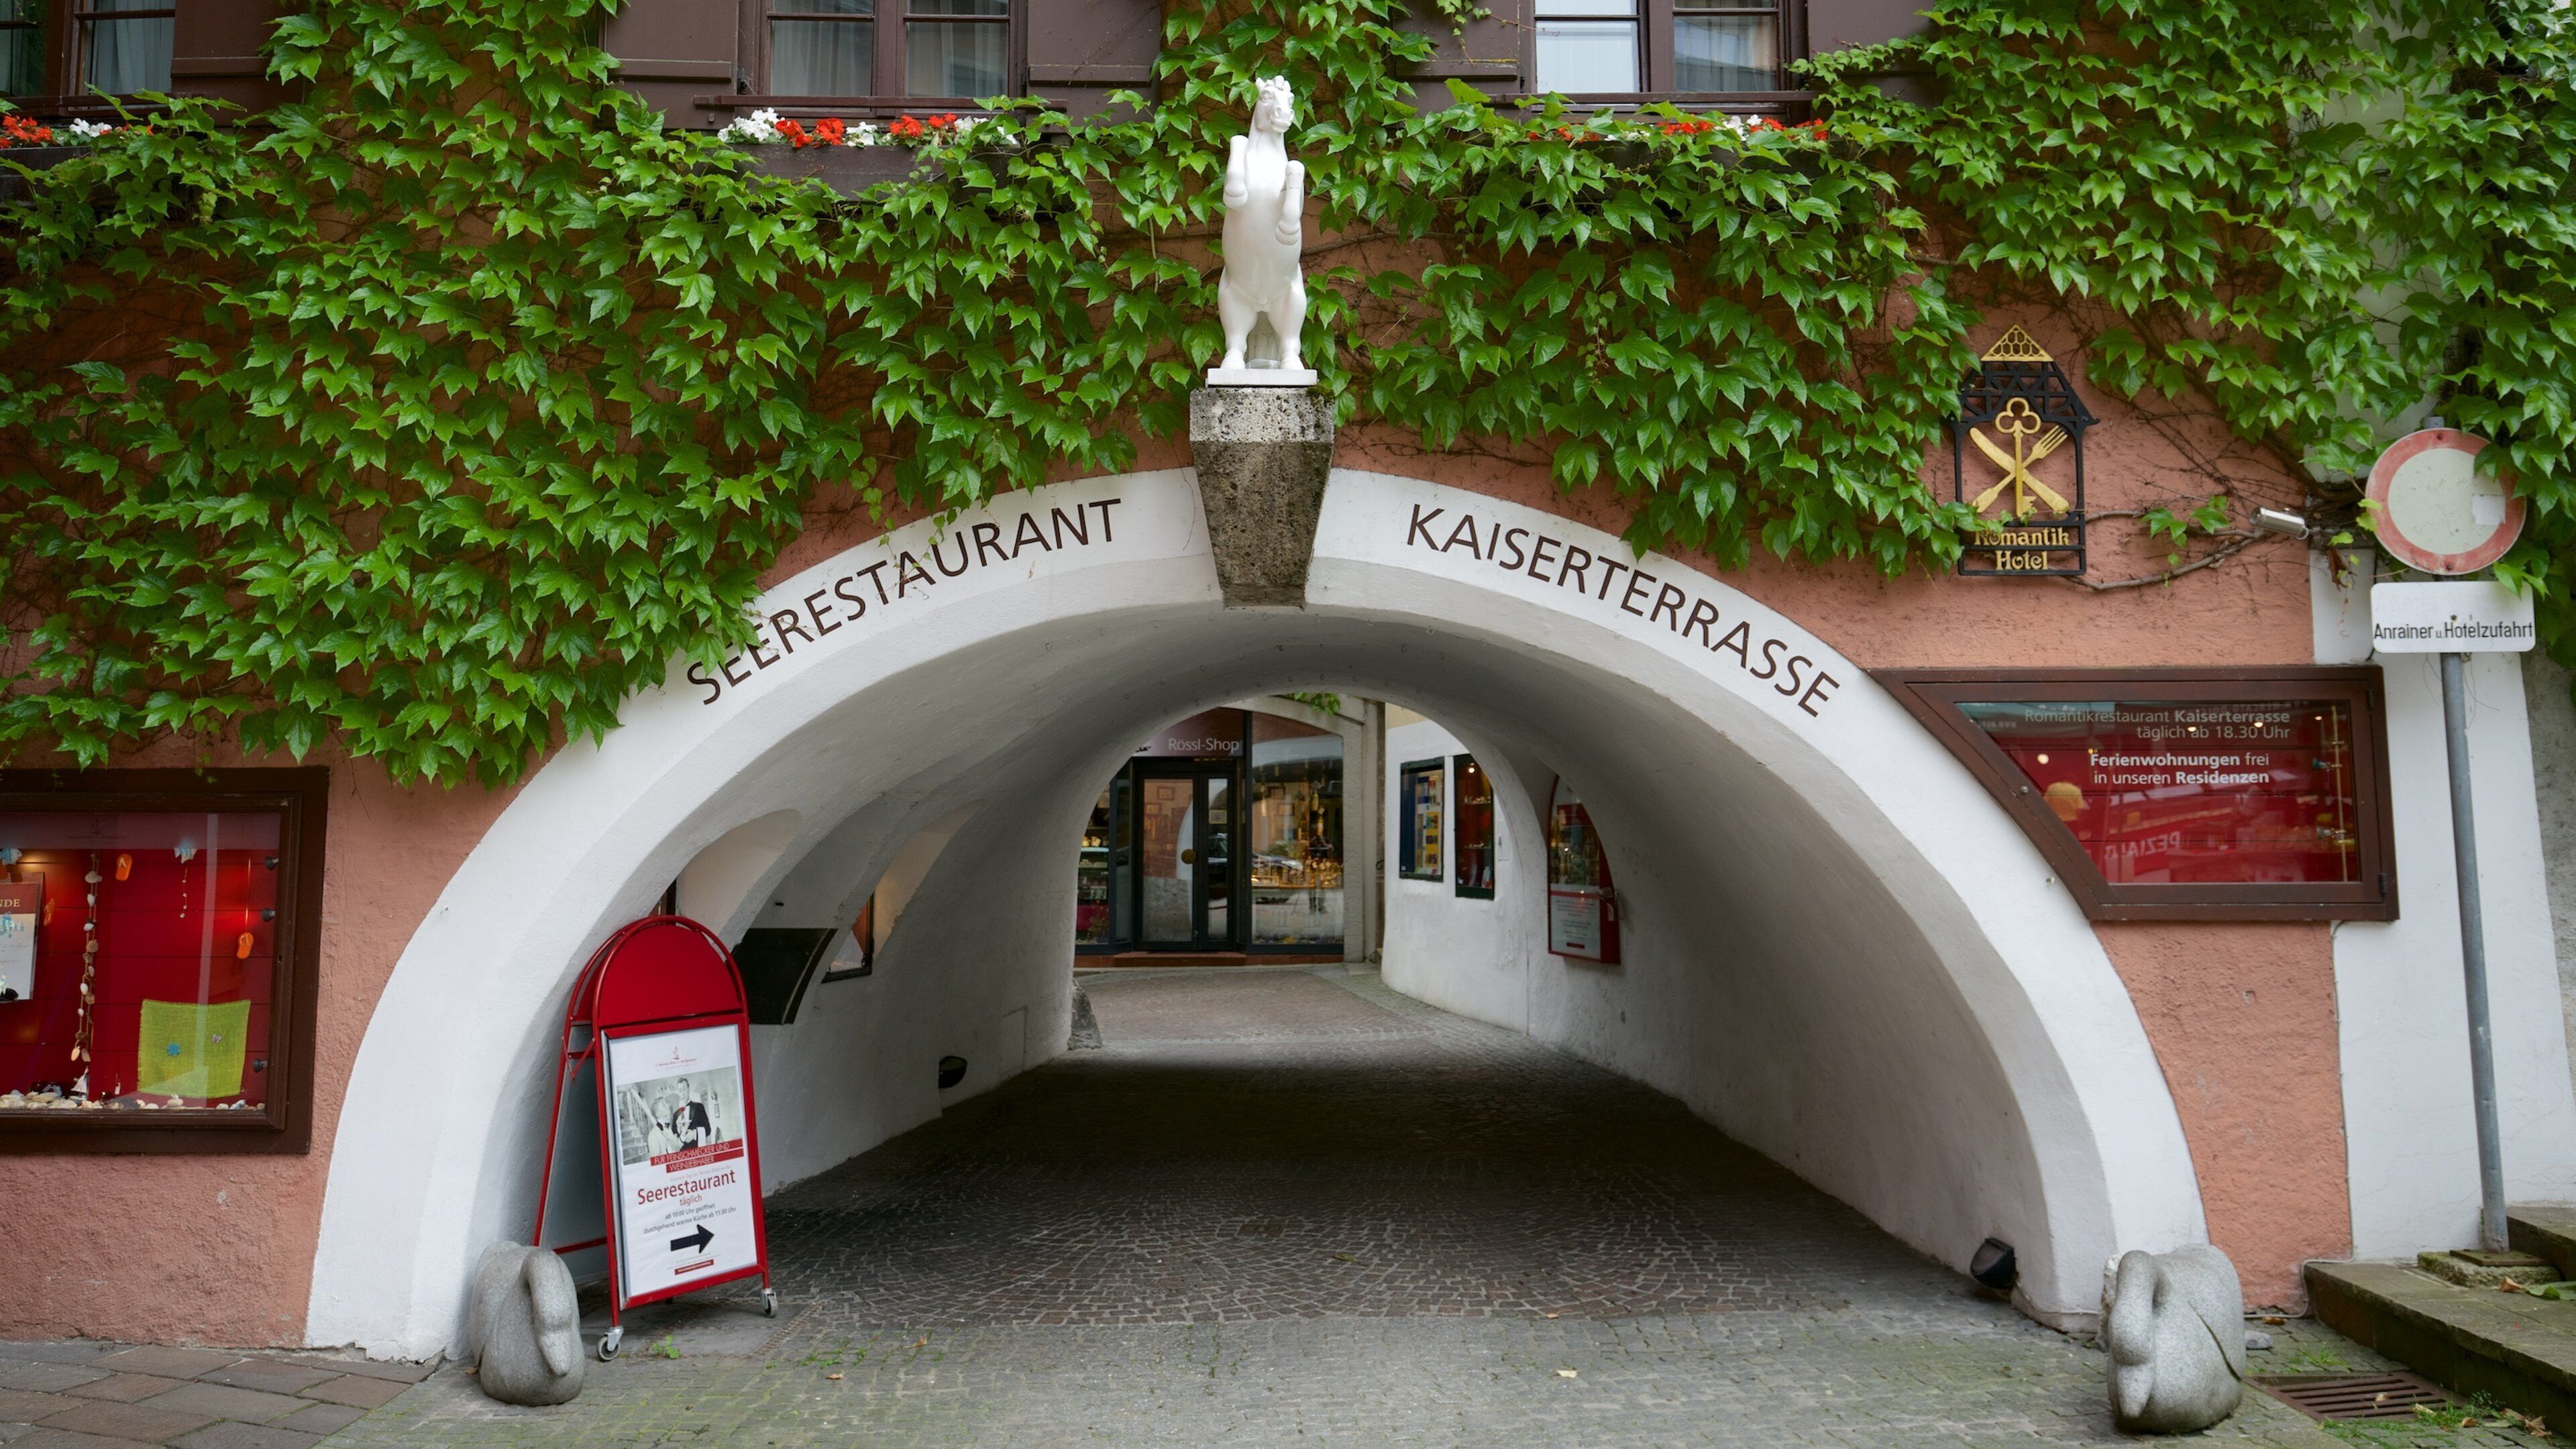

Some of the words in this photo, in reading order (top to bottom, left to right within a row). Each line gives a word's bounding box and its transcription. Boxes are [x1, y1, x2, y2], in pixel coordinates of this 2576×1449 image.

[1974, 527, 2070, 546] Romantik
[1995, 550, 2048, 570] Hotel
[687, 498, 1122, 706] SEERESTAURANT
[1407, 504, 1840, 718] KAISERTERRASSE
[2374, 623, 2434, 639] Anrainer
[2445, 621, 2534, 639] Hotelzufahrt
[2025, 709, 2170, 722] Romantikrestaurant
[2174, 709, 2290, 722] Kaiserterrasse
[2137, 725, 2186, 741] täglich
[2190, 725, 2209, 739] ab
[2216, 726, 2258, 739] 18.30
[2263, 726, 2290, 739] Uhr
[1168, 738, 1240, 753] Rössl-Shop
[2090, 753, 2241, 769] Ferienwohnungen
[2245, 752, 2269, 766] frei
[2094, 771, 2107, 784] in
[2112, 773, 2171, 784] unseren
[2176, 771, 2269, 784] Residenzen
[716, 1142, 730, 1152] UND
[637, 1170, 736, 1205] Seerestaurant
[680, 1193, 702, 1207] täglich
[672, 1210, 685, 1218] 10:00
[686, 1208, 694, 1216] Uhr
[696, 1203, 715, 1214] geöffnet
[643, 1220, 676, 1234] durchgehend
[676, 1218, 692, 1226] warme
[693, 1214, 708, 1222] Küche
